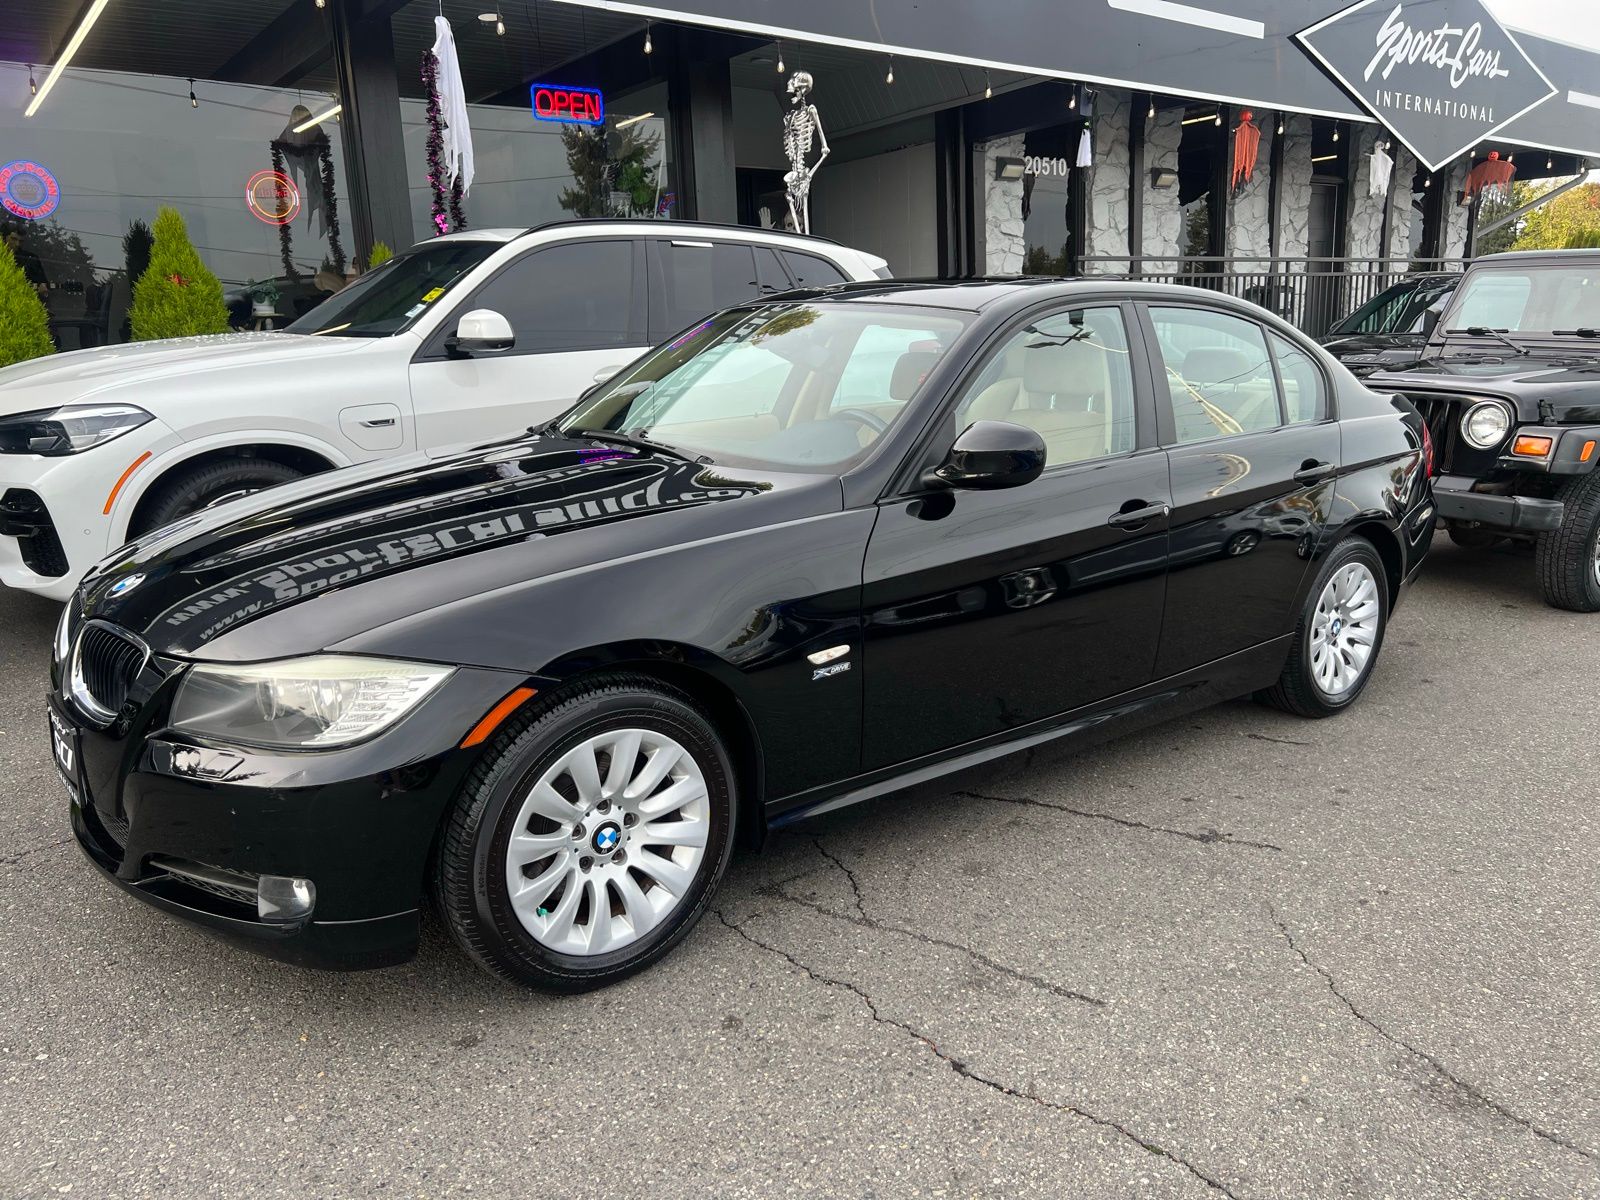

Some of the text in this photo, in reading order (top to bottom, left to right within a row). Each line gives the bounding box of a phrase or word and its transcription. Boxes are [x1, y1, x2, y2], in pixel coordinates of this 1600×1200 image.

[1364, 3, 1509, 89] Sports Cars
[535, 89, 600, 120] OPEN
[1376, 90, 1494, 123] INTERNATIONAL
[1024, 156, 1067, 177] 20510
